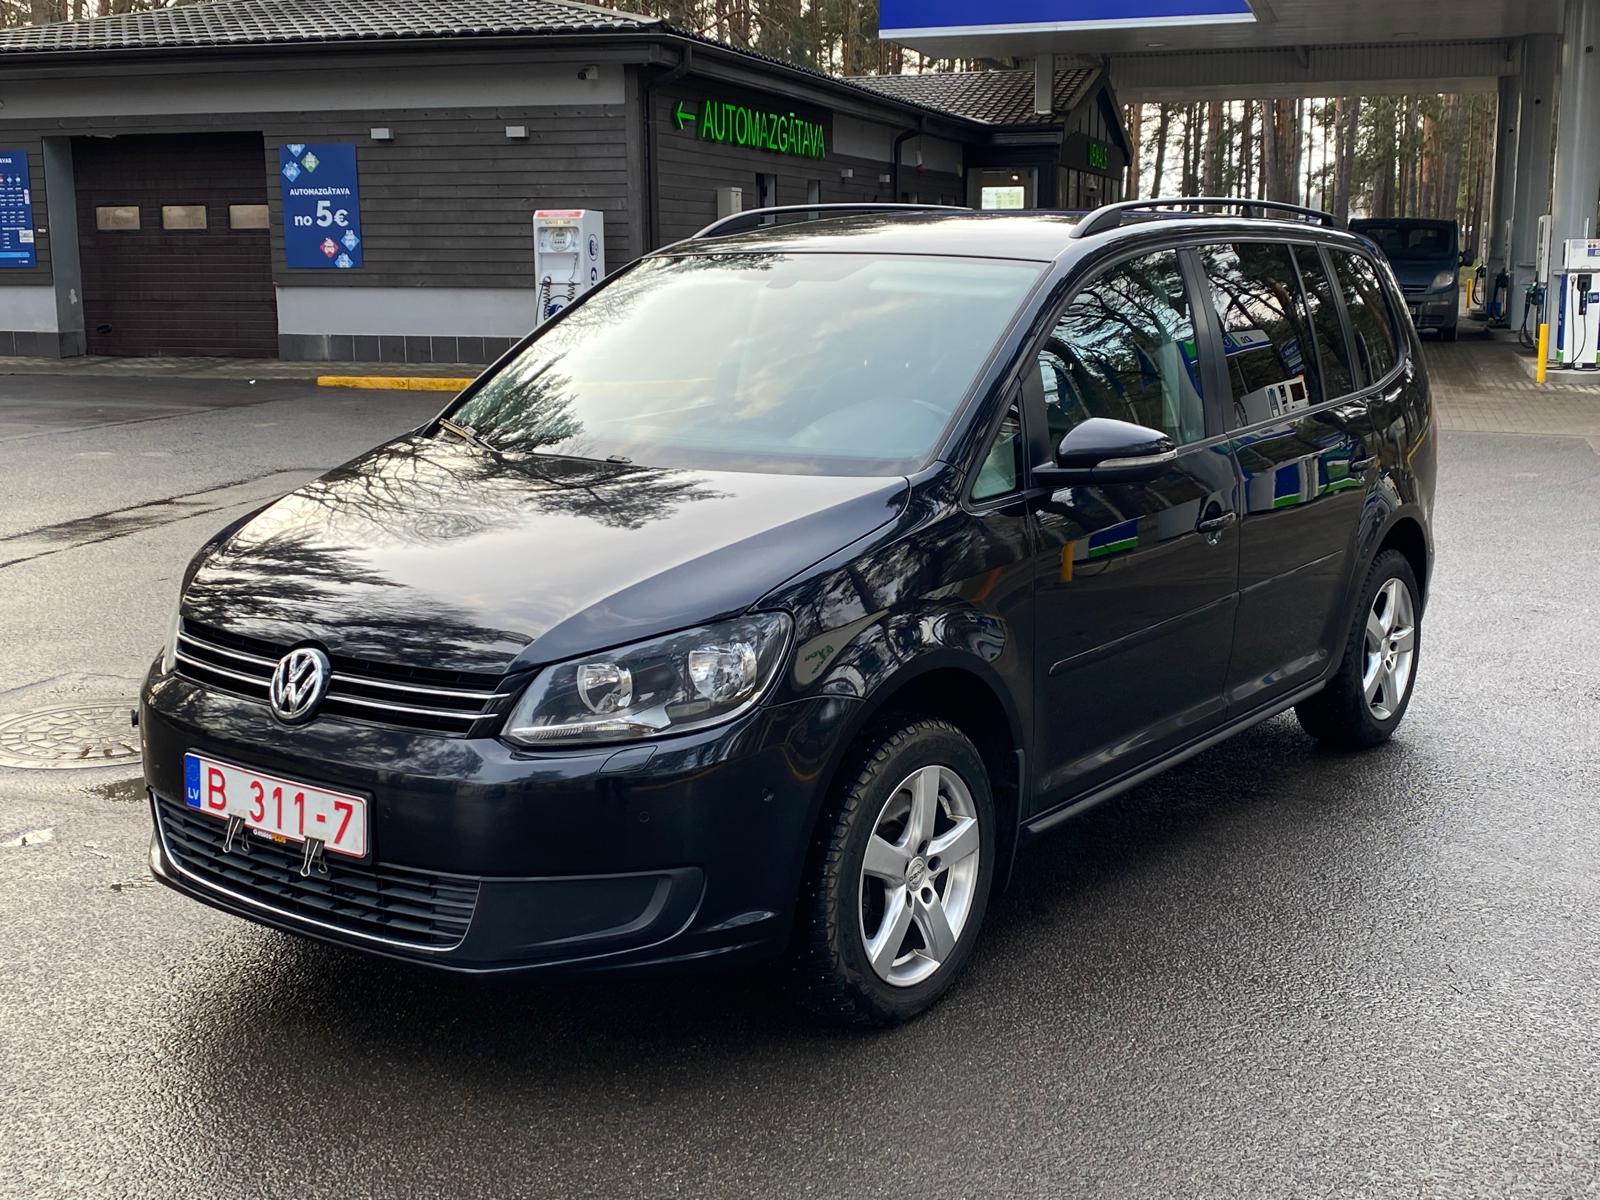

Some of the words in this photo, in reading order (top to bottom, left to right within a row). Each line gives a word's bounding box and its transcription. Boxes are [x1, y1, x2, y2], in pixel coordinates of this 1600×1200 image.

[702, 99, 825, 158] AUTOMAZGĀTAVA
[289, 186, 351, 196] AUTOMAZGĀTAVA
[294, 215, 312, 226] no
[316, 200, 349, 227] 5€
[188, 786, 200, 800] LV
[208, 766, 227, 811] B
[249, 779, 353, 845] 311-7
